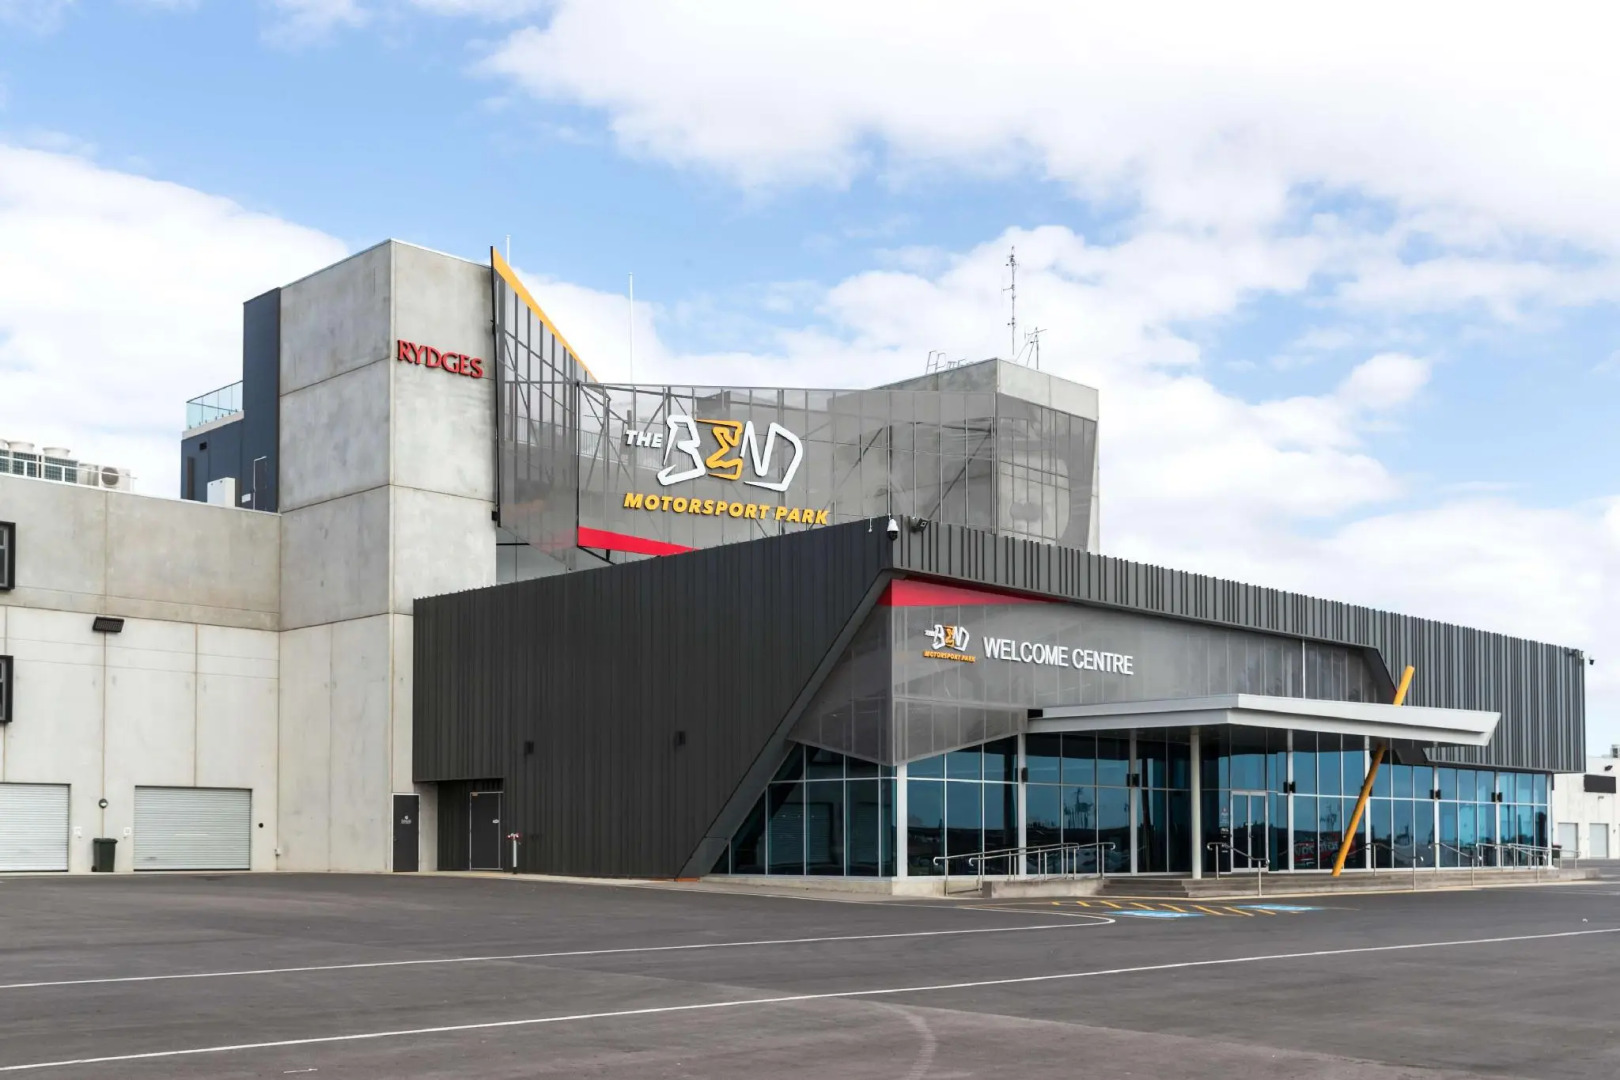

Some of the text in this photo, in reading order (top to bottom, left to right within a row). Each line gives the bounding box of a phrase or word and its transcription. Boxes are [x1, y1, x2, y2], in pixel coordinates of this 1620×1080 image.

[397, 339, 483, 379] RYDGES
[625, 414, 804, 493] THE BEND
[623, 493, 829, 526] MOTORSPORT PARK
[982, 636, 1134, 676] WELCOME CENTRE
